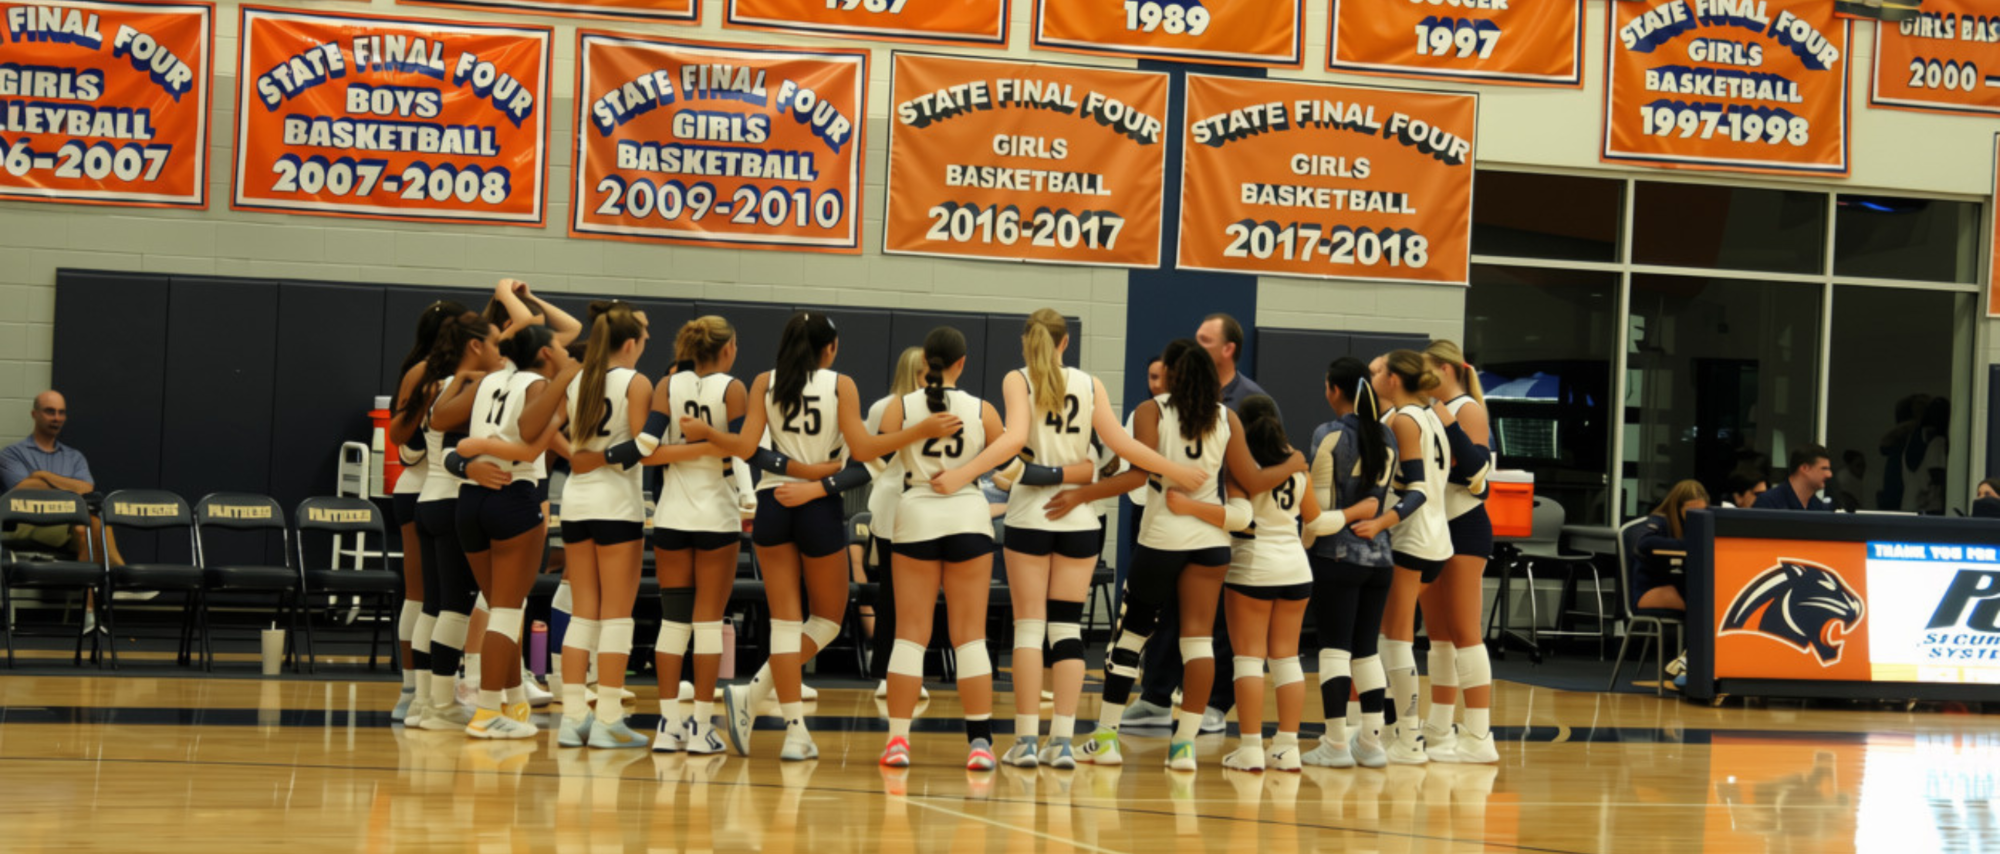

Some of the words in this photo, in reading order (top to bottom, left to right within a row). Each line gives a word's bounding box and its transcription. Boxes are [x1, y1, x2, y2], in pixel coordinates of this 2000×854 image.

[1124, 1, 1210, 36] 1989
[1620, 0, 1688, 51] STATE
[1696, 0, 1770, 25] FINAL
[1775, 9, 1840, 71] FOUR
[8, 6, 103, 44] FINAL
[114, 24, 193, 94] FOUR
[1415, 25, 1502, 59] 1997
[1687, 39, 1763, 66] GIRLS
[0, 66, 101, 101] GIRLS
[257, 42, 345, 107] STATE
[353, 35, 445, 74] FINAL
[454, 52, 533, 119] FOUR
[1645, 69, 1803, 103] BASKETBALL
[1908, 61, 1977, 92] 2000
[346, 87, 439, 118] BOYS
[593, 70, 674, 128] STATE
[681, 64, 767, 99] FINAL
[777, 79, 851, 144] FOUR
[898, 81, 989, 126] STATE
[996, 79, 1078, 109] FINAL
[1085, 91, 1162, 143] FOUR
[0, 105, 153, 140] LEYBALL
[284, 117, 497, 156] BASKETBALL
[672, 112, 768, 143] GIRLS
[1191, 102, 1286, 144] STATE
[1294, 100, 1382, 130] FINAL
[1389, 112, 1470, 164] FOUR
[1640, 105, 1810, 146] 1997-1998
[0, 140, 171, 182] 6-2007
[617, 143, 815, 181] BASKETBALL
[992, 134, 1068, 159] GIRLS
[271, 158, 507, 204] 2007-2008
[946, 165, 1111, 195] BASKETBALL
[1290, 154, 1371, 179] GIRLS
[595, 178, 841, 228] 2009-2010
[1241, 183, 1416, 214] BASKETBALL
[925, 206, 1125, 250] 2016-2017
[1223, 224, 1428, 268] 2017-2018
[485, 388, 511, 426] 11
[781, 396, 821, 436] 25
[1045, 394, 1081, 434] 42
[1874, 544, 1926, 559] THANK
[1929, 545, 1962, 560] YOU
